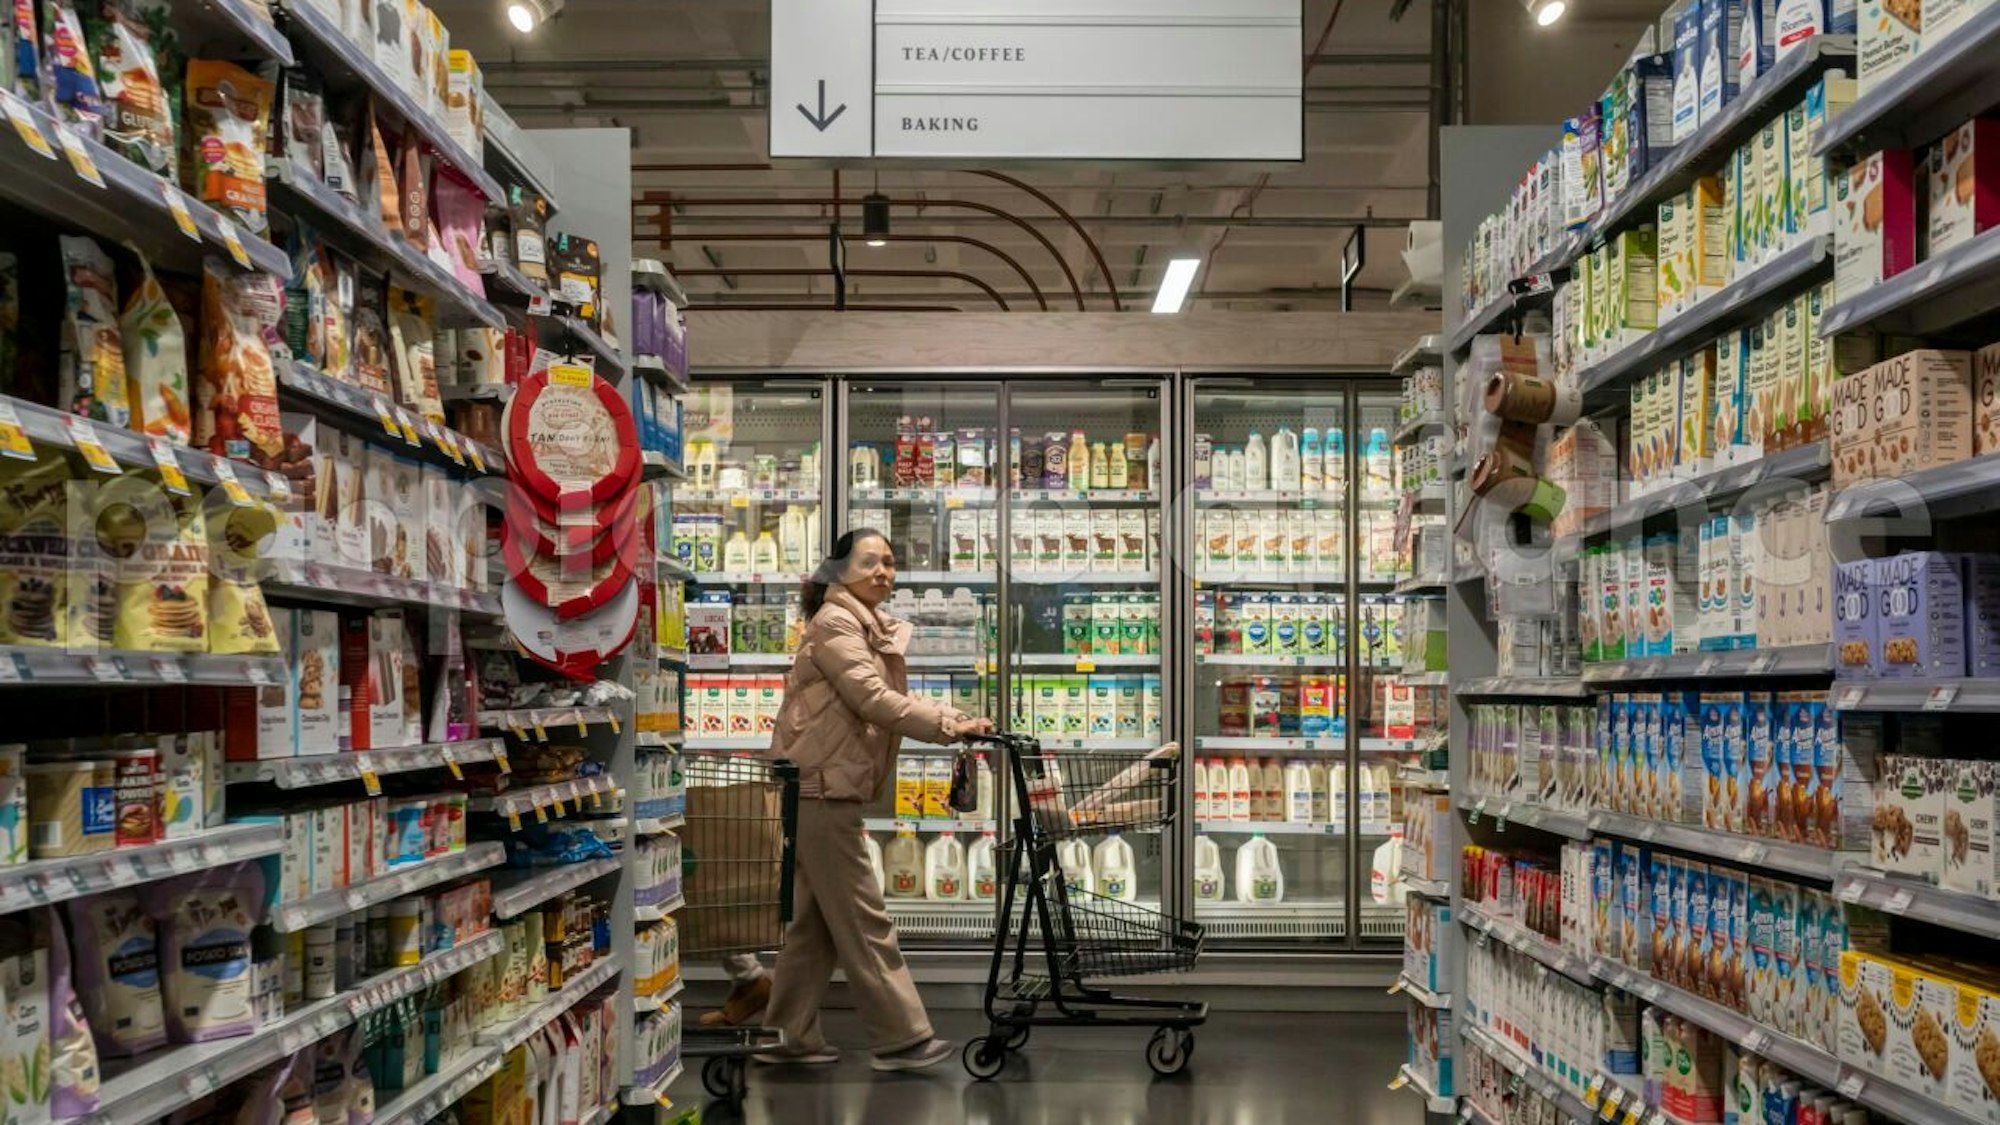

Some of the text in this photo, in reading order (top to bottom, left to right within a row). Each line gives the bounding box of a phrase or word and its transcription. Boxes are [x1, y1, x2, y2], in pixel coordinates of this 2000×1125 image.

[902, 46, 1026, 62] TEA/COFFEE
[901, 117, 979, 132] BAKING
[1874, 357, 1911, 388] MADE
[1833, 374, 1868, 409] MADE
[530, 433, 555, 443] TAN
[1835, 564, 1868, 594] MADE
[1880, 558, 1918, 587] MADE
[1880, 587, 1918, 617] GOOD
[1915, 814, 1938, 824] CHEWY
